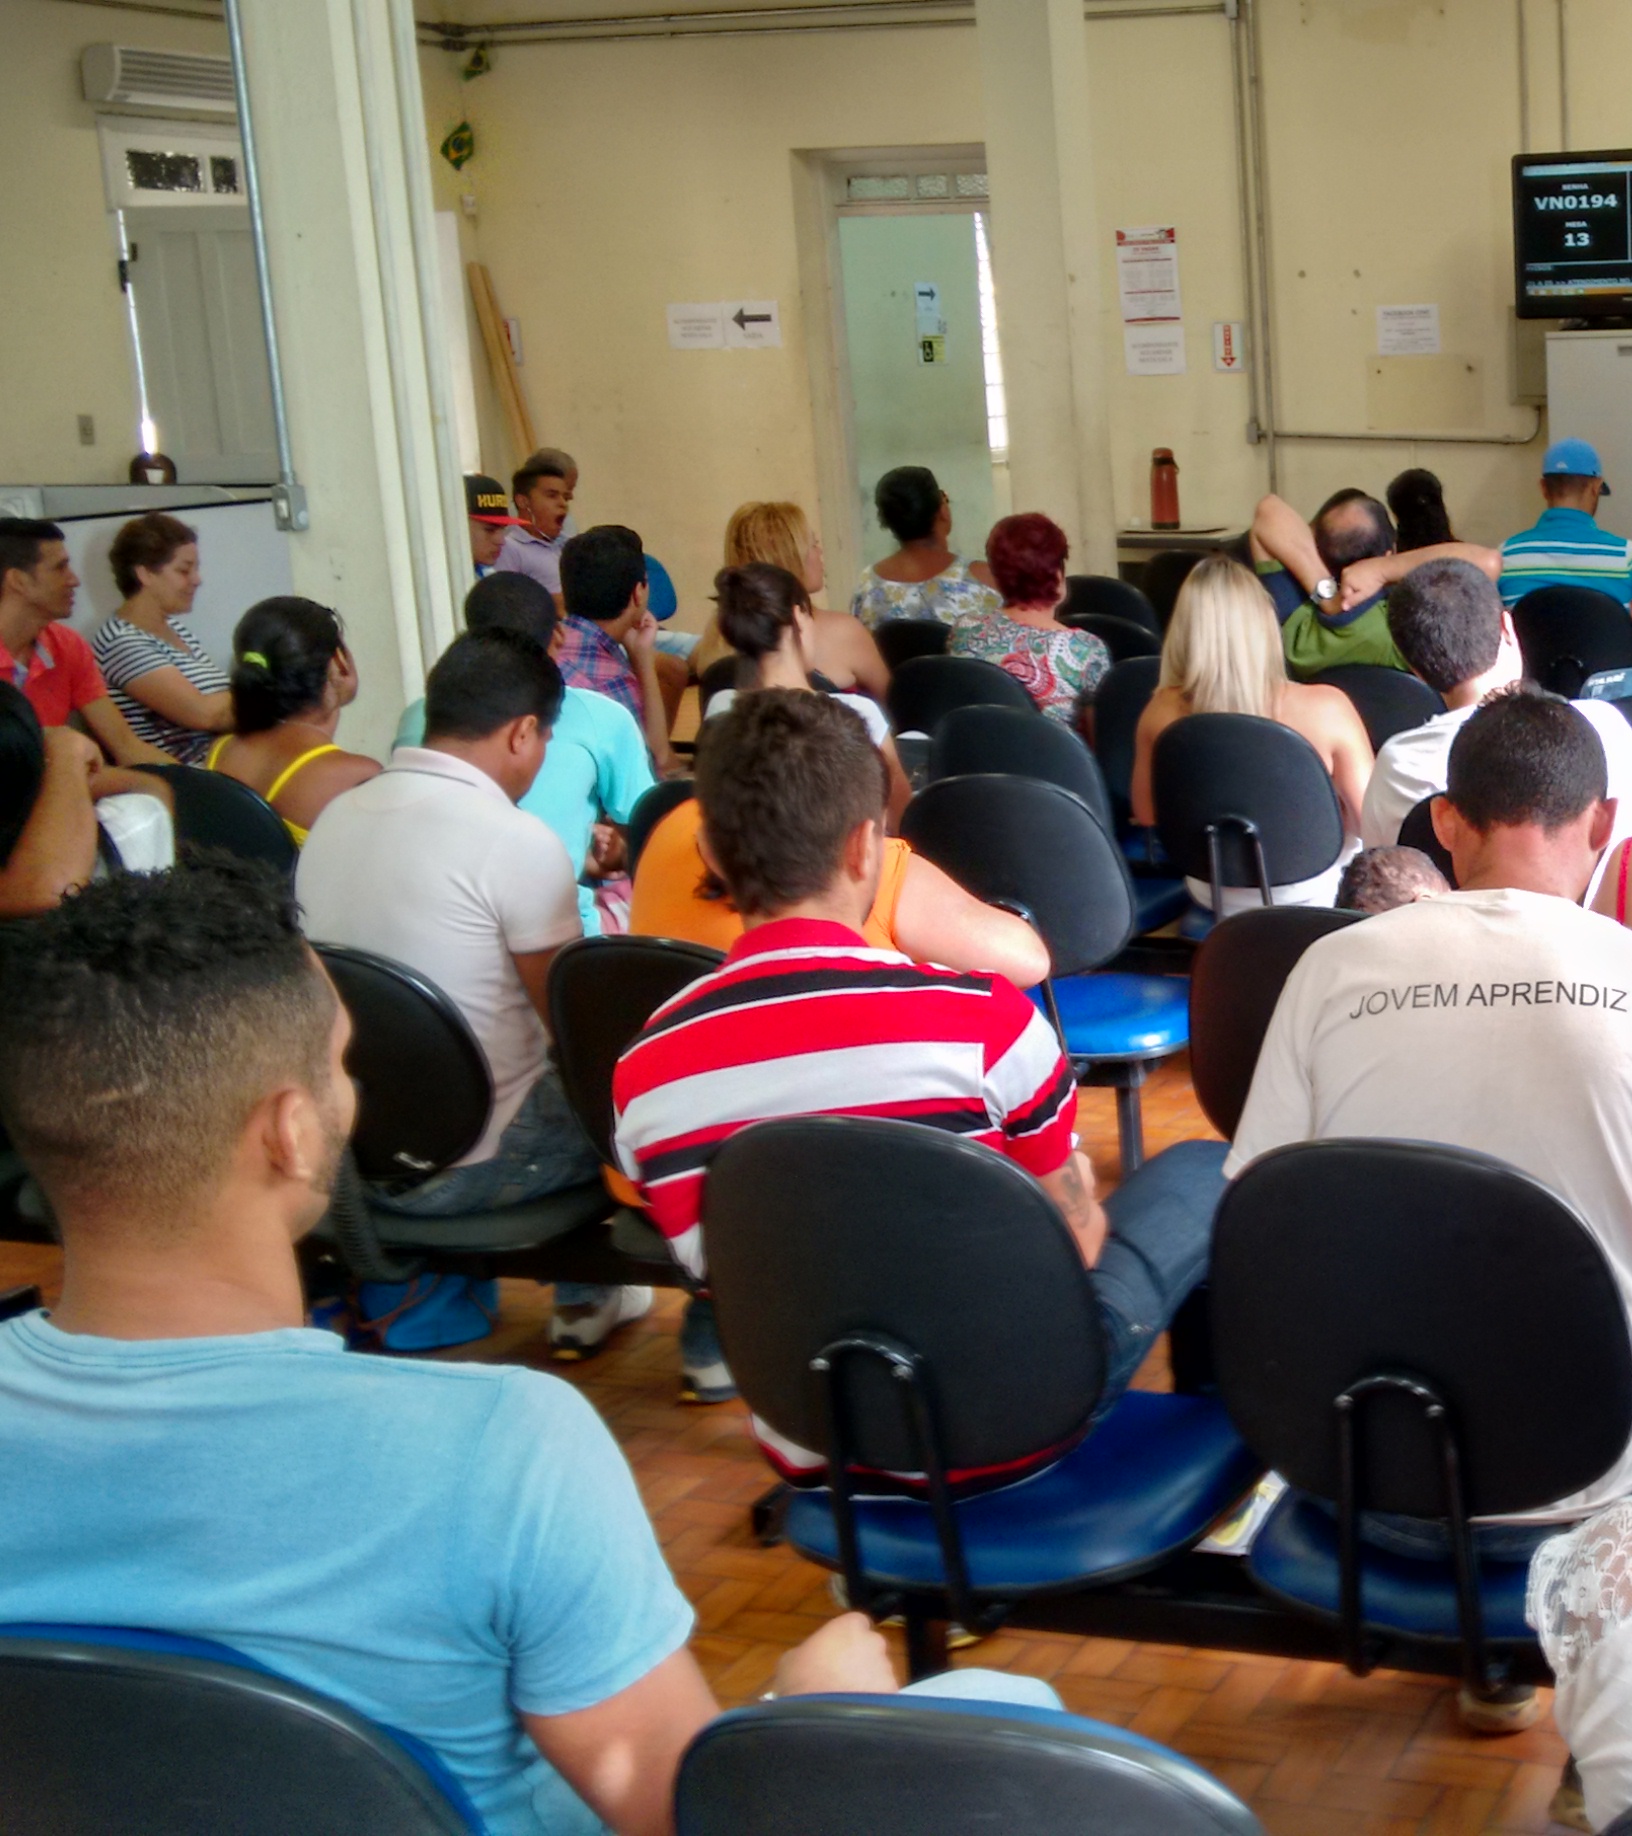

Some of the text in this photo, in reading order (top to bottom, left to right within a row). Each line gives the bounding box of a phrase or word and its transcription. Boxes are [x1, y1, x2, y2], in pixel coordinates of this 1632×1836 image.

[1534, 193, 1618, 210] VN0194
[1564, 232, 1590, 247] 13
[1349, 980, 1629, 1020] JOVEM APRENDIZ
